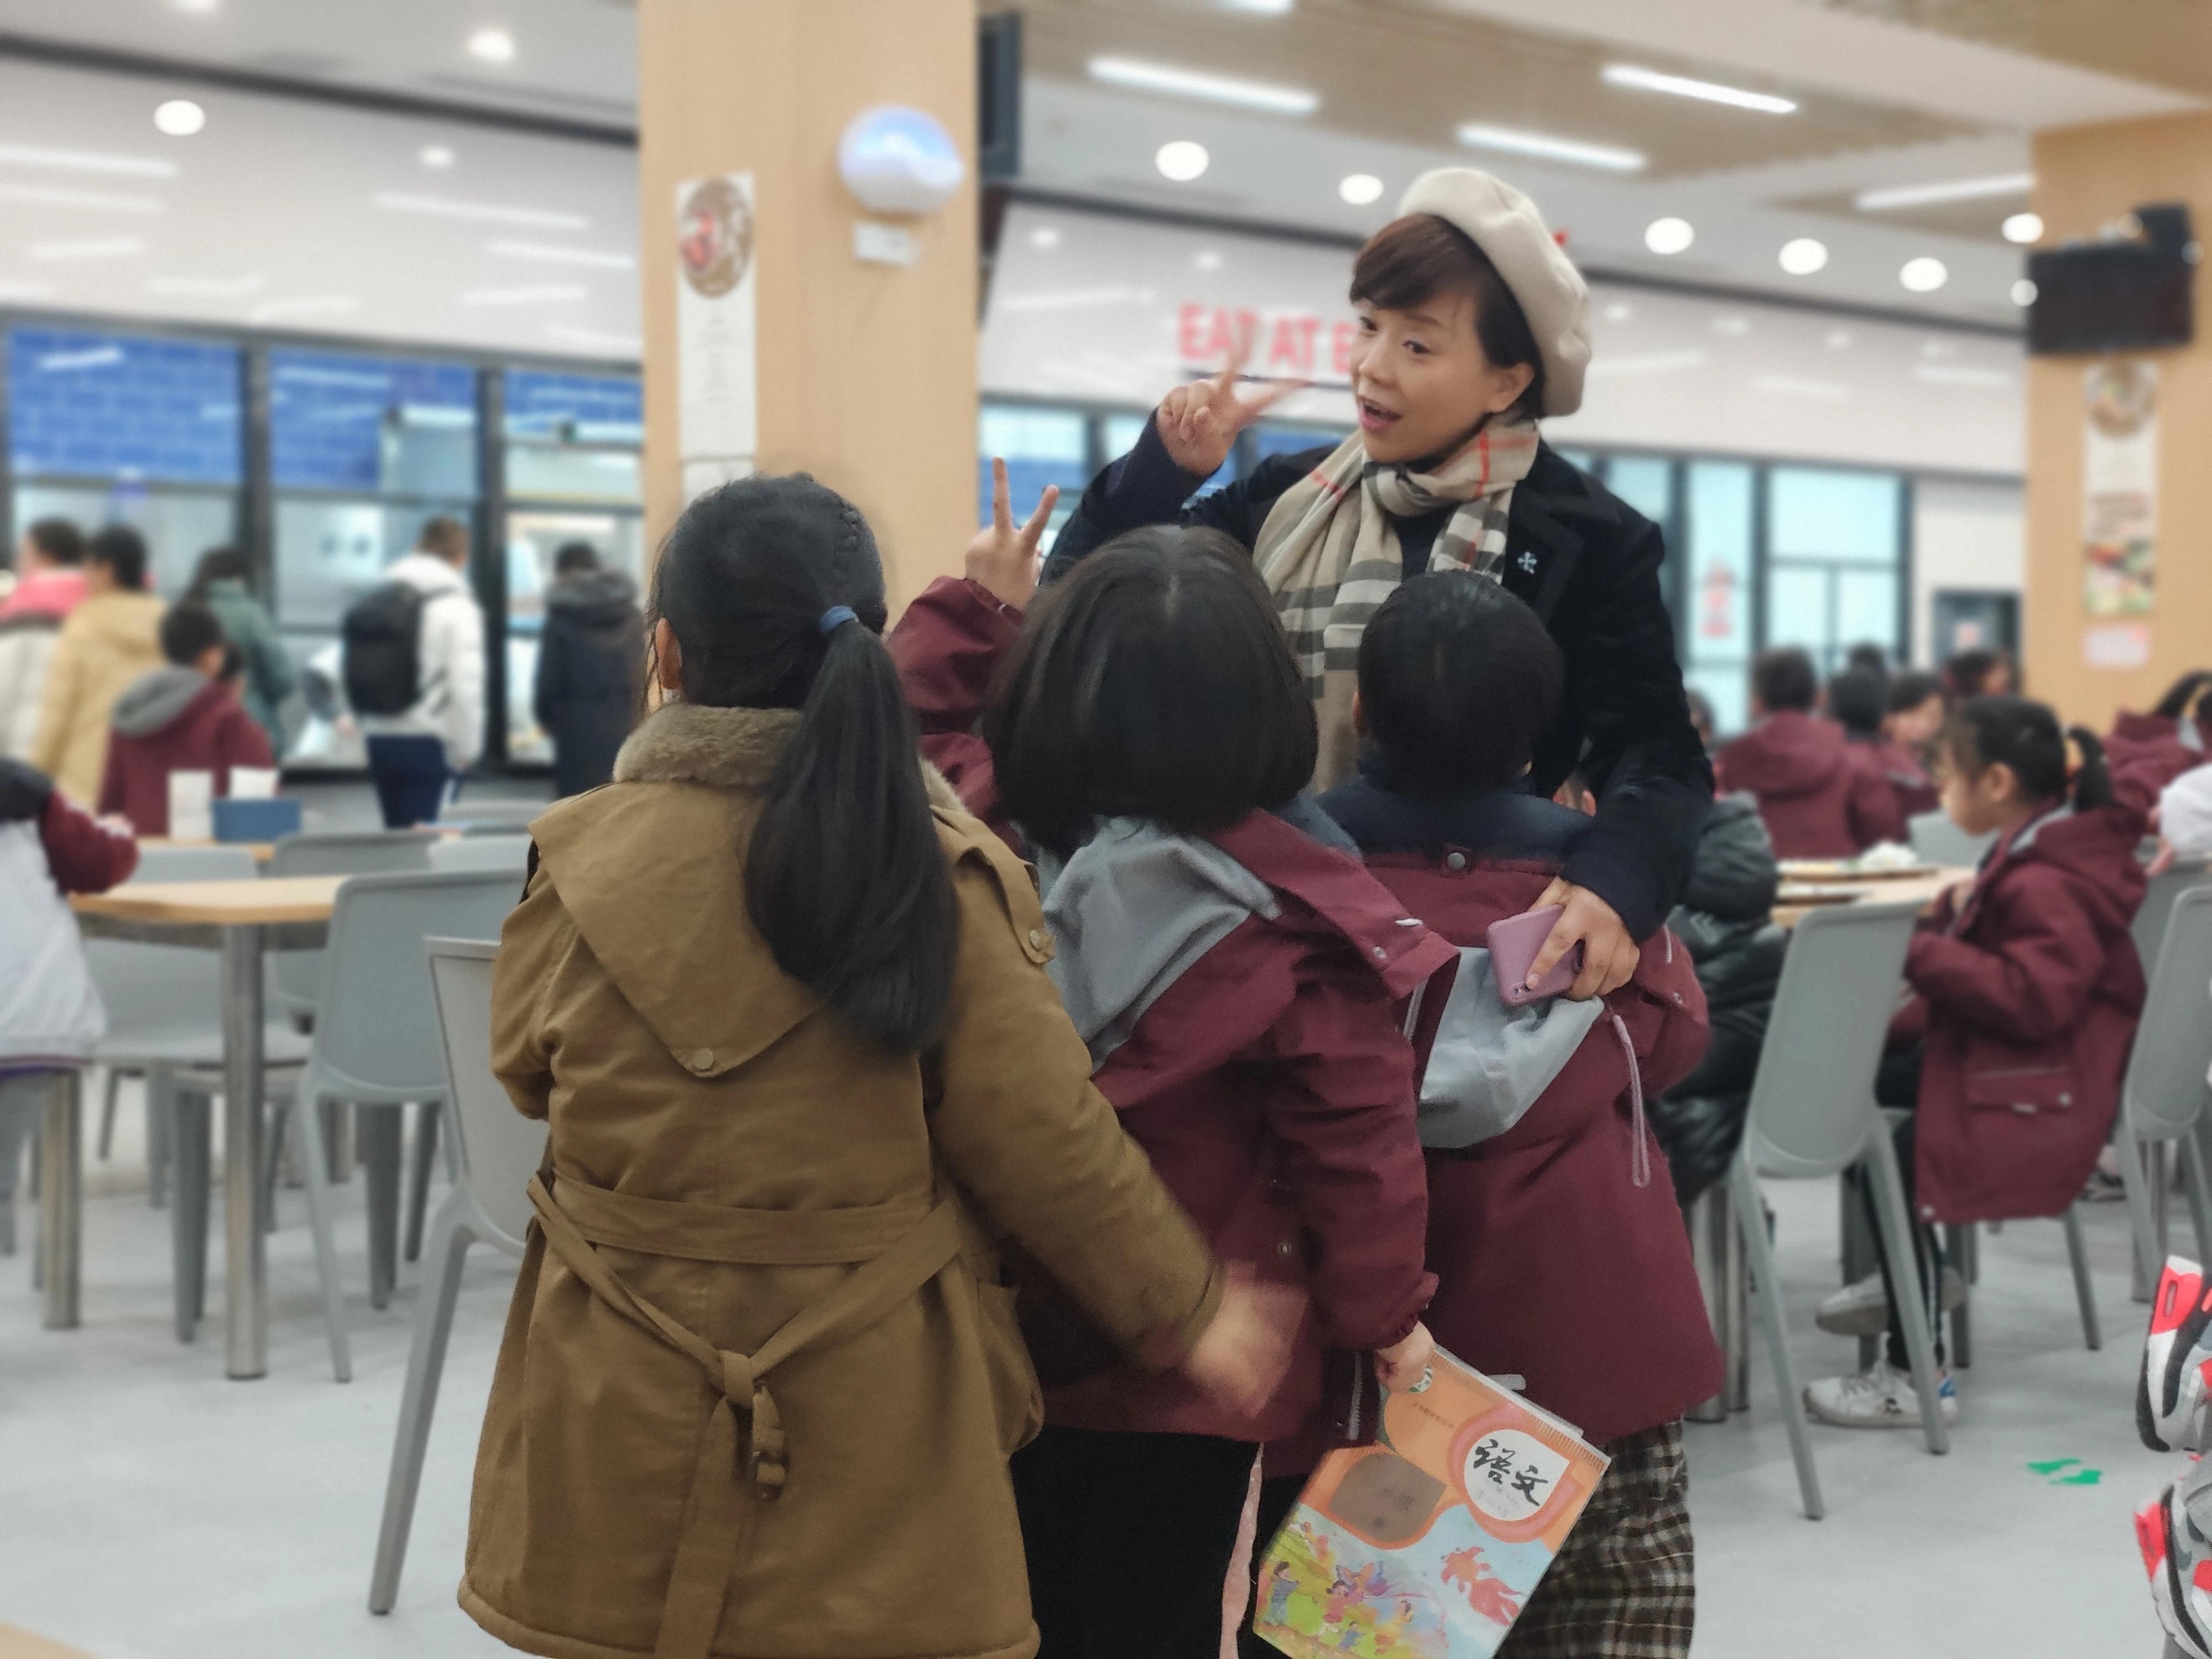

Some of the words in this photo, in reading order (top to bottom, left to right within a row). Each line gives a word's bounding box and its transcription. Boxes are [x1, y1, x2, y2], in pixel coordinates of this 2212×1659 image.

[1180, 302, 1259, 362] EAT
[1270, 315, 1321, 368] AT
[1473, 1439, 1548, 1506] 语文
